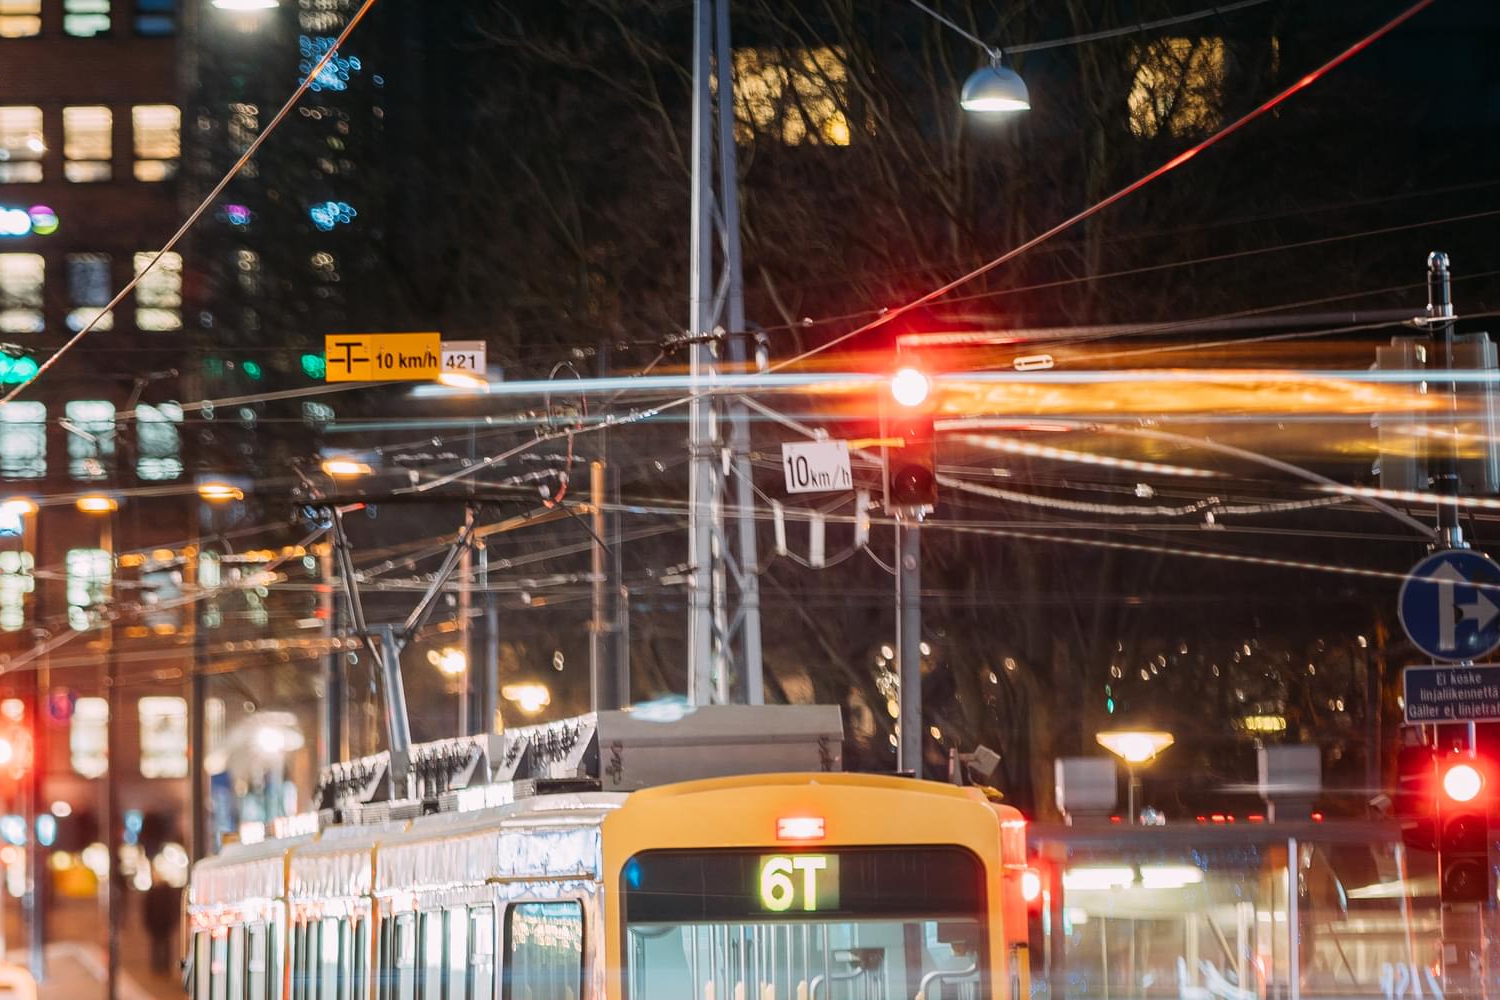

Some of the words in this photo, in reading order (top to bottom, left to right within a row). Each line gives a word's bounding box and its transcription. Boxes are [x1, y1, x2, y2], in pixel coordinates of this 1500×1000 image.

[375, 352, 393, 369] 10
[399, 351, 437, 369] km/h
[446, 354, 476, 369] 421
[1436, 671, 1447, 686] Ei
[1450, 671, 1482, 686] koske
[760, 856, 826, 911] 6T
